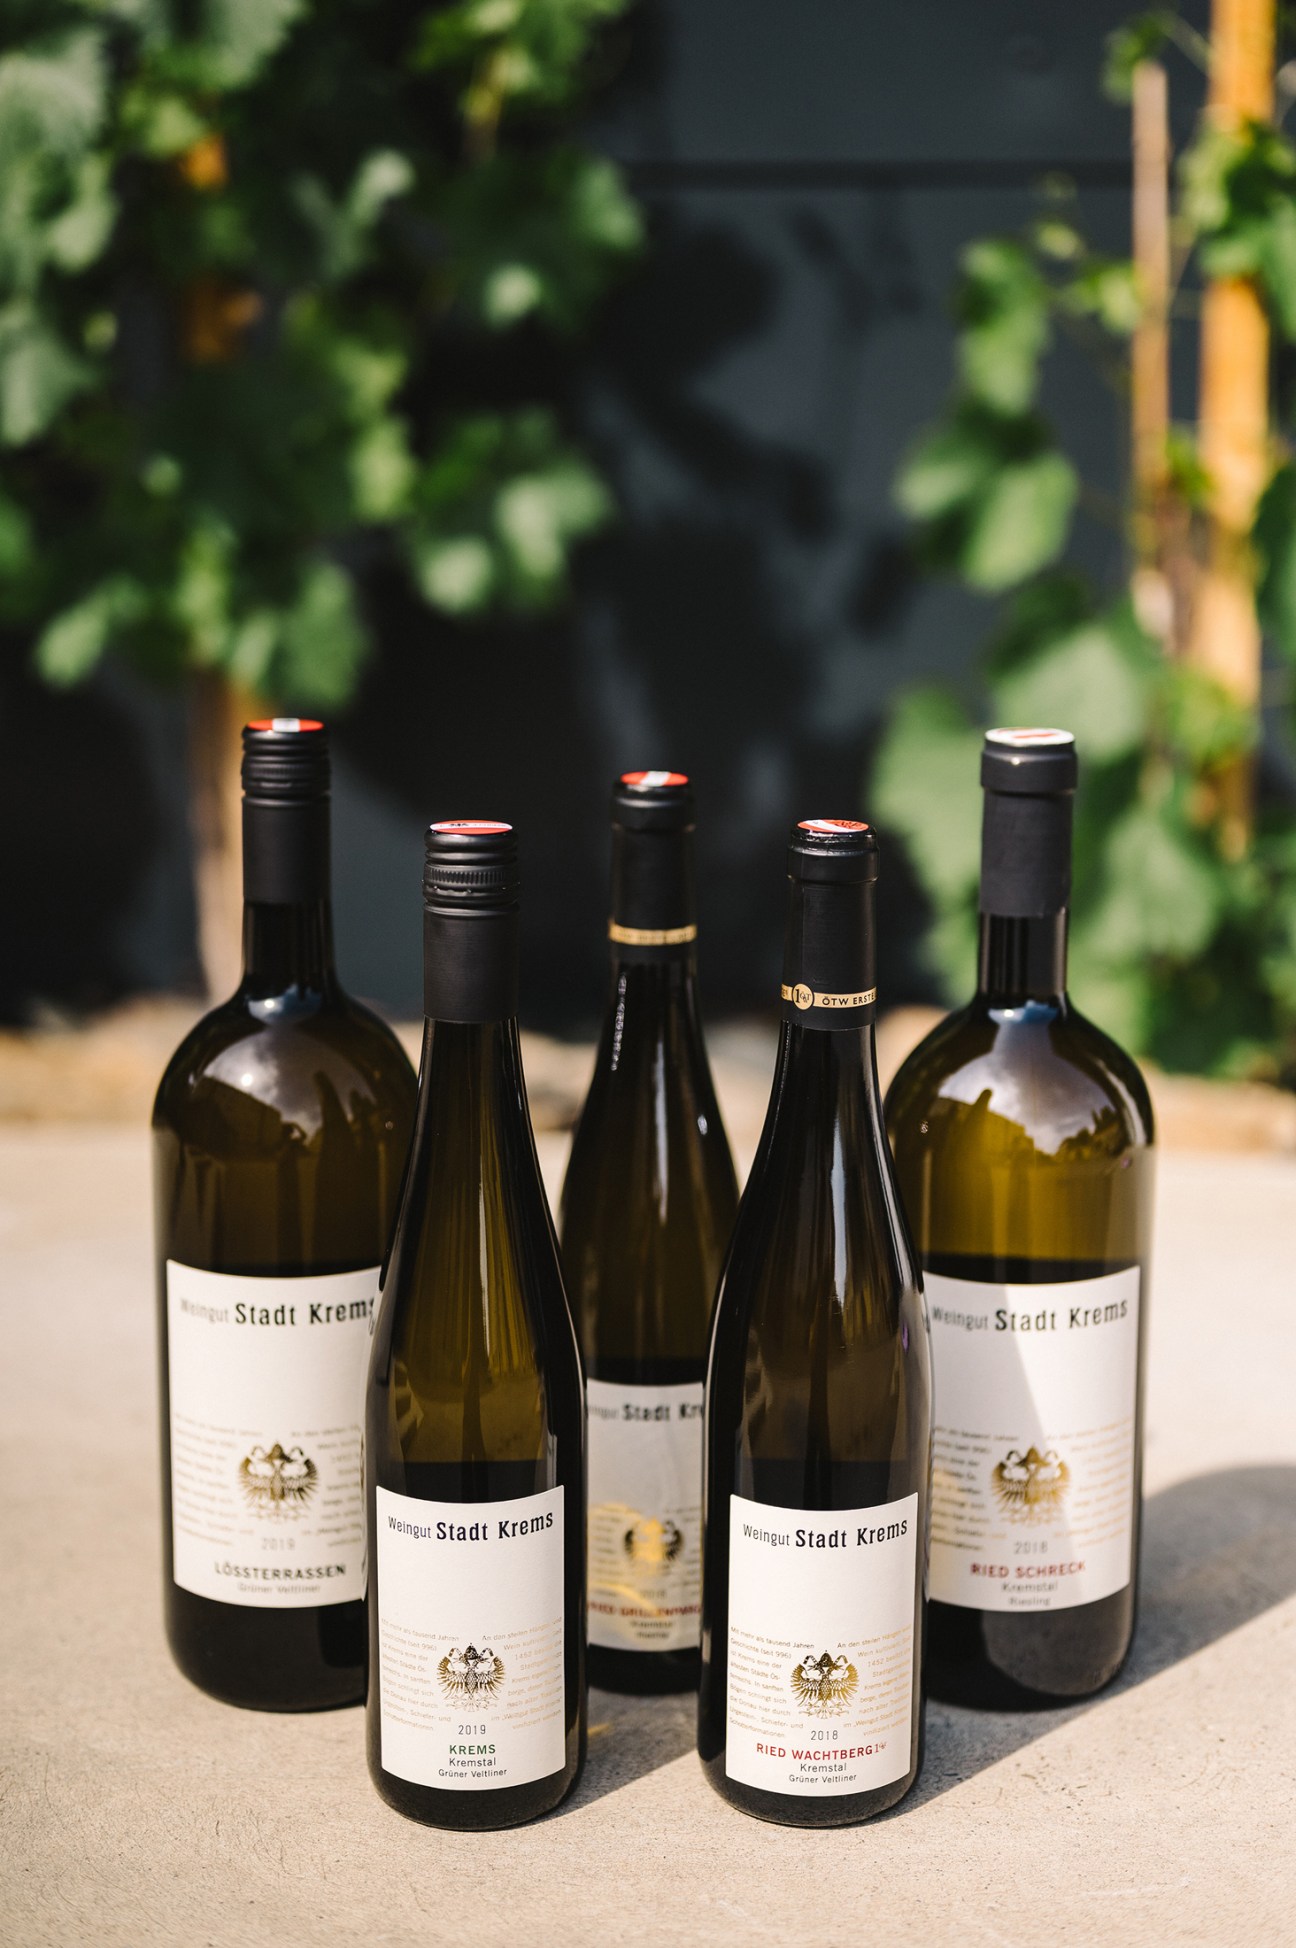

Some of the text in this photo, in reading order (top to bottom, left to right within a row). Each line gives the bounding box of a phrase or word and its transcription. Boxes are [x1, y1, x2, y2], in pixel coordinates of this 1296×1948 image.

[822, 996, 849, 1006] ÖTW
[180, 1299, 229, 1324] Weingut
[235, 1302, 296, 1326] Stadt
[931, 1299, 1128, 1332] Weingut Stadt Krems
[623, 1403, 670, 1421] Stadt
[388, 1512, 553, 1541] Weingut Stadt Krems
[743, 1519, 908, 1548] Weingut Stadt Krems
[214, 1560, 347, 1580] LÖSSTERRASSEN
[971, 1560, 1086, 1579] RIED SCHRECK
[458, 1724, 486, 1735] 2019
[810, 1730, 839, 1741] 2018
[449, 1744, 496, 1755] KREMS
[756, 1743, 786, 1758] RIED
[791, 1745, 873, 1761] WACHTBERG
[449, 1757, 496, 1767] Kremstal
[800, 1762, 847, 1773] Kremstal
[438, 1768, 508, 1778] Grüner Veltliner
[788, 1774, 857, 1784] Grüner Veltliner
